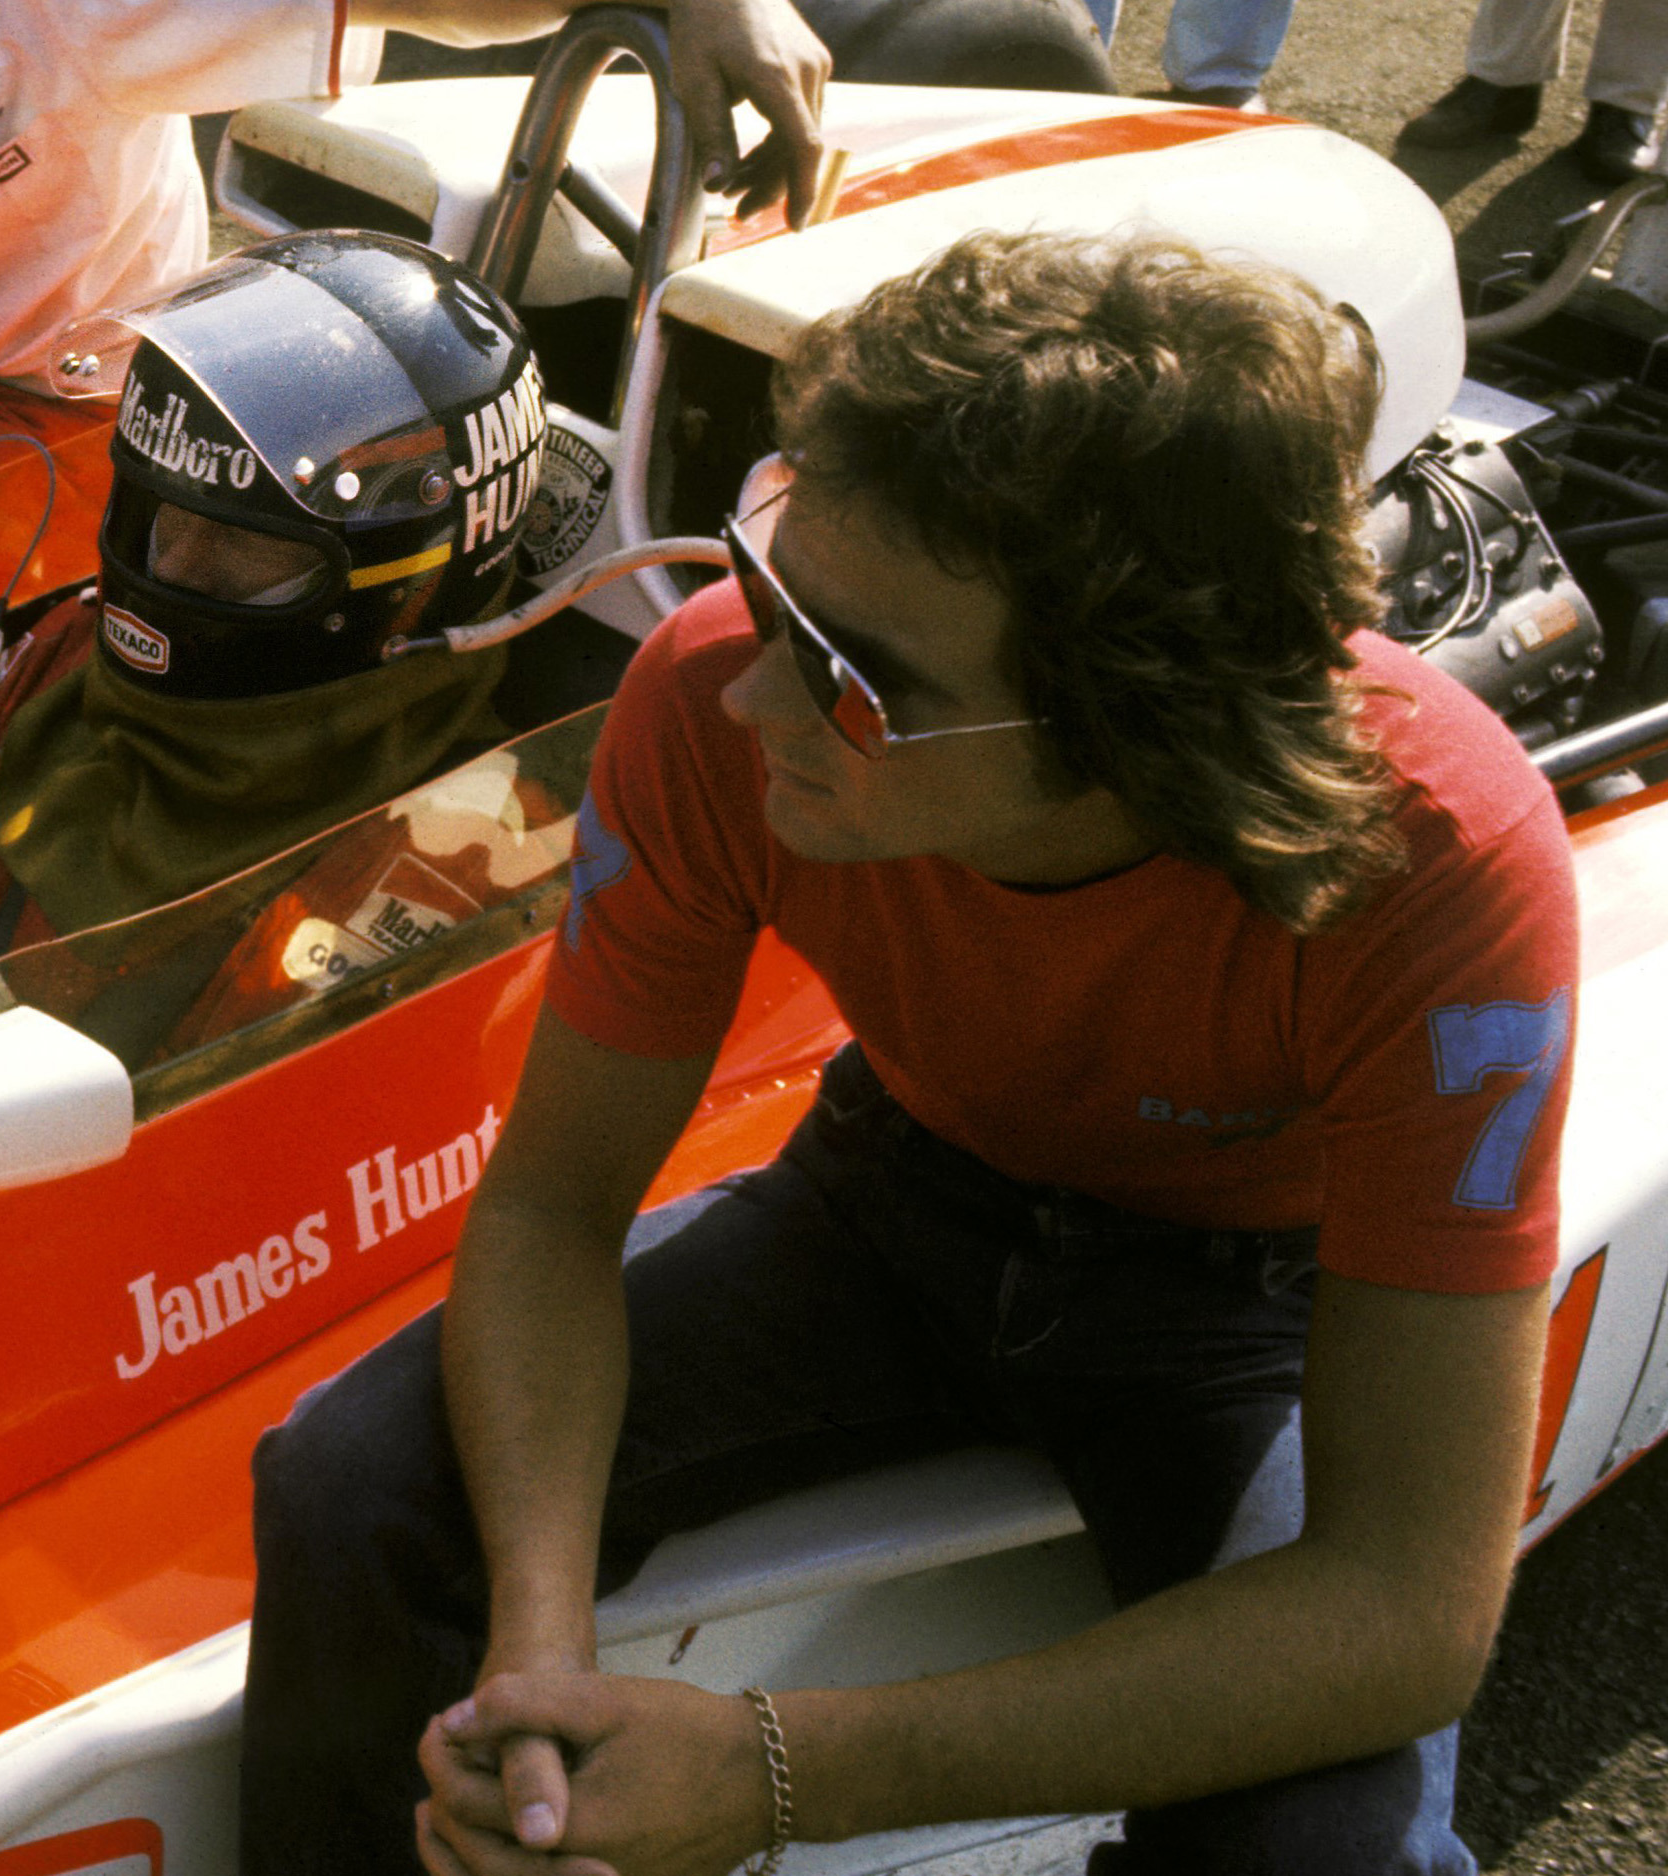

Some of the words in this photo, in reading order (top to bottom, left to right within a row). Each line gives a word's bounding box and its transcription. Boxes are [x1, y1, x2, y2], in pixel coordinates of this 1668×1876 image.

[118, 370, 257, 489] Marlboro
[453, 352, 545, 487] JAME
[543, 427, 605, 483] TINEER
[463, 436, 544, 555] HU
[531, 488, 609, 573] TECHNICAL
[107, 618, 160, 659] TEXACO
[1429, 984, 1572, 1211] 7
[115, 1271, 331, 1380] James
[346, 1103, 502, 1253] Hunt
